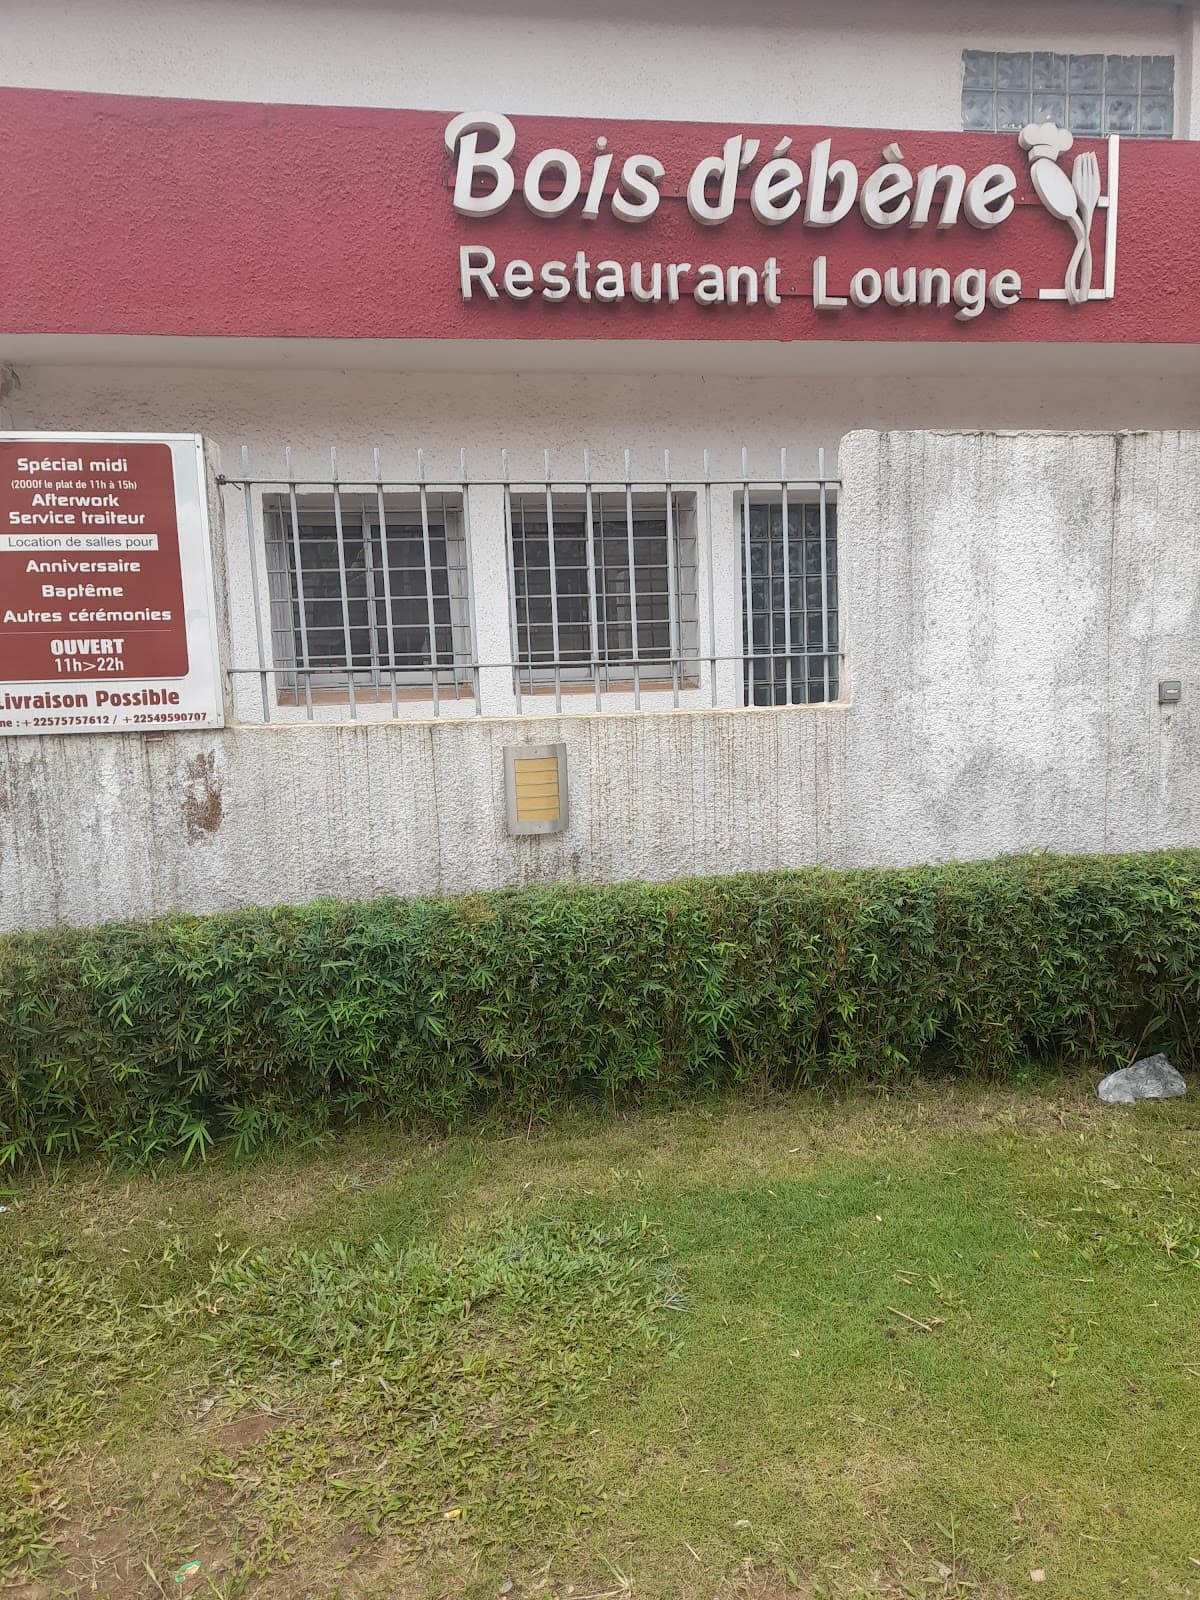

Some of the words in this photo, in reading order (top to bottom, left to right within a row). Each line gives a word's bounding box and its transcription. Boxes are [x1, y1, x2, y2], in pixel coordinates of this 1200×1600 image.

[445, 111, 665, 223] Bois
[687, 134, 1017, 229] d'ébène
[459, 245, 781, 307] Restaurant
[813, 255, 1021, 321] Lounge
[17, 458, 83, 474] Spécial
[89, 458, 128, 472] midi
[11, 480, 42, 489] (2000f
[44, 480, 52, 489] le
[55, 480, 73, 490] plat
[75, 480, 87, 489] de
[90, 480, 106, 489] 11h
[109, 480, 115, 489] à
[118, 480, 137, 490] 15h)
[31, 493, 120, 507] Afterwork
[9, 511, 76, 524] Service
[81, 511, 145, 524] traiteur
[8, 536, 62, 547] Location
[65, 536, 82, 547] de
[85, 536, 122, 547] salles
[125, 538, 154, 551] pour
[26, 559, 141, 573] Anniversaire
[41, 584, 124, 600] Baptême
[4, 610, 62, 623] Autres
[68, 607, 172, 622] cérémonies
[50, 638, 125, 655] OUVERT
[95, 688, 180, 707] Possible
